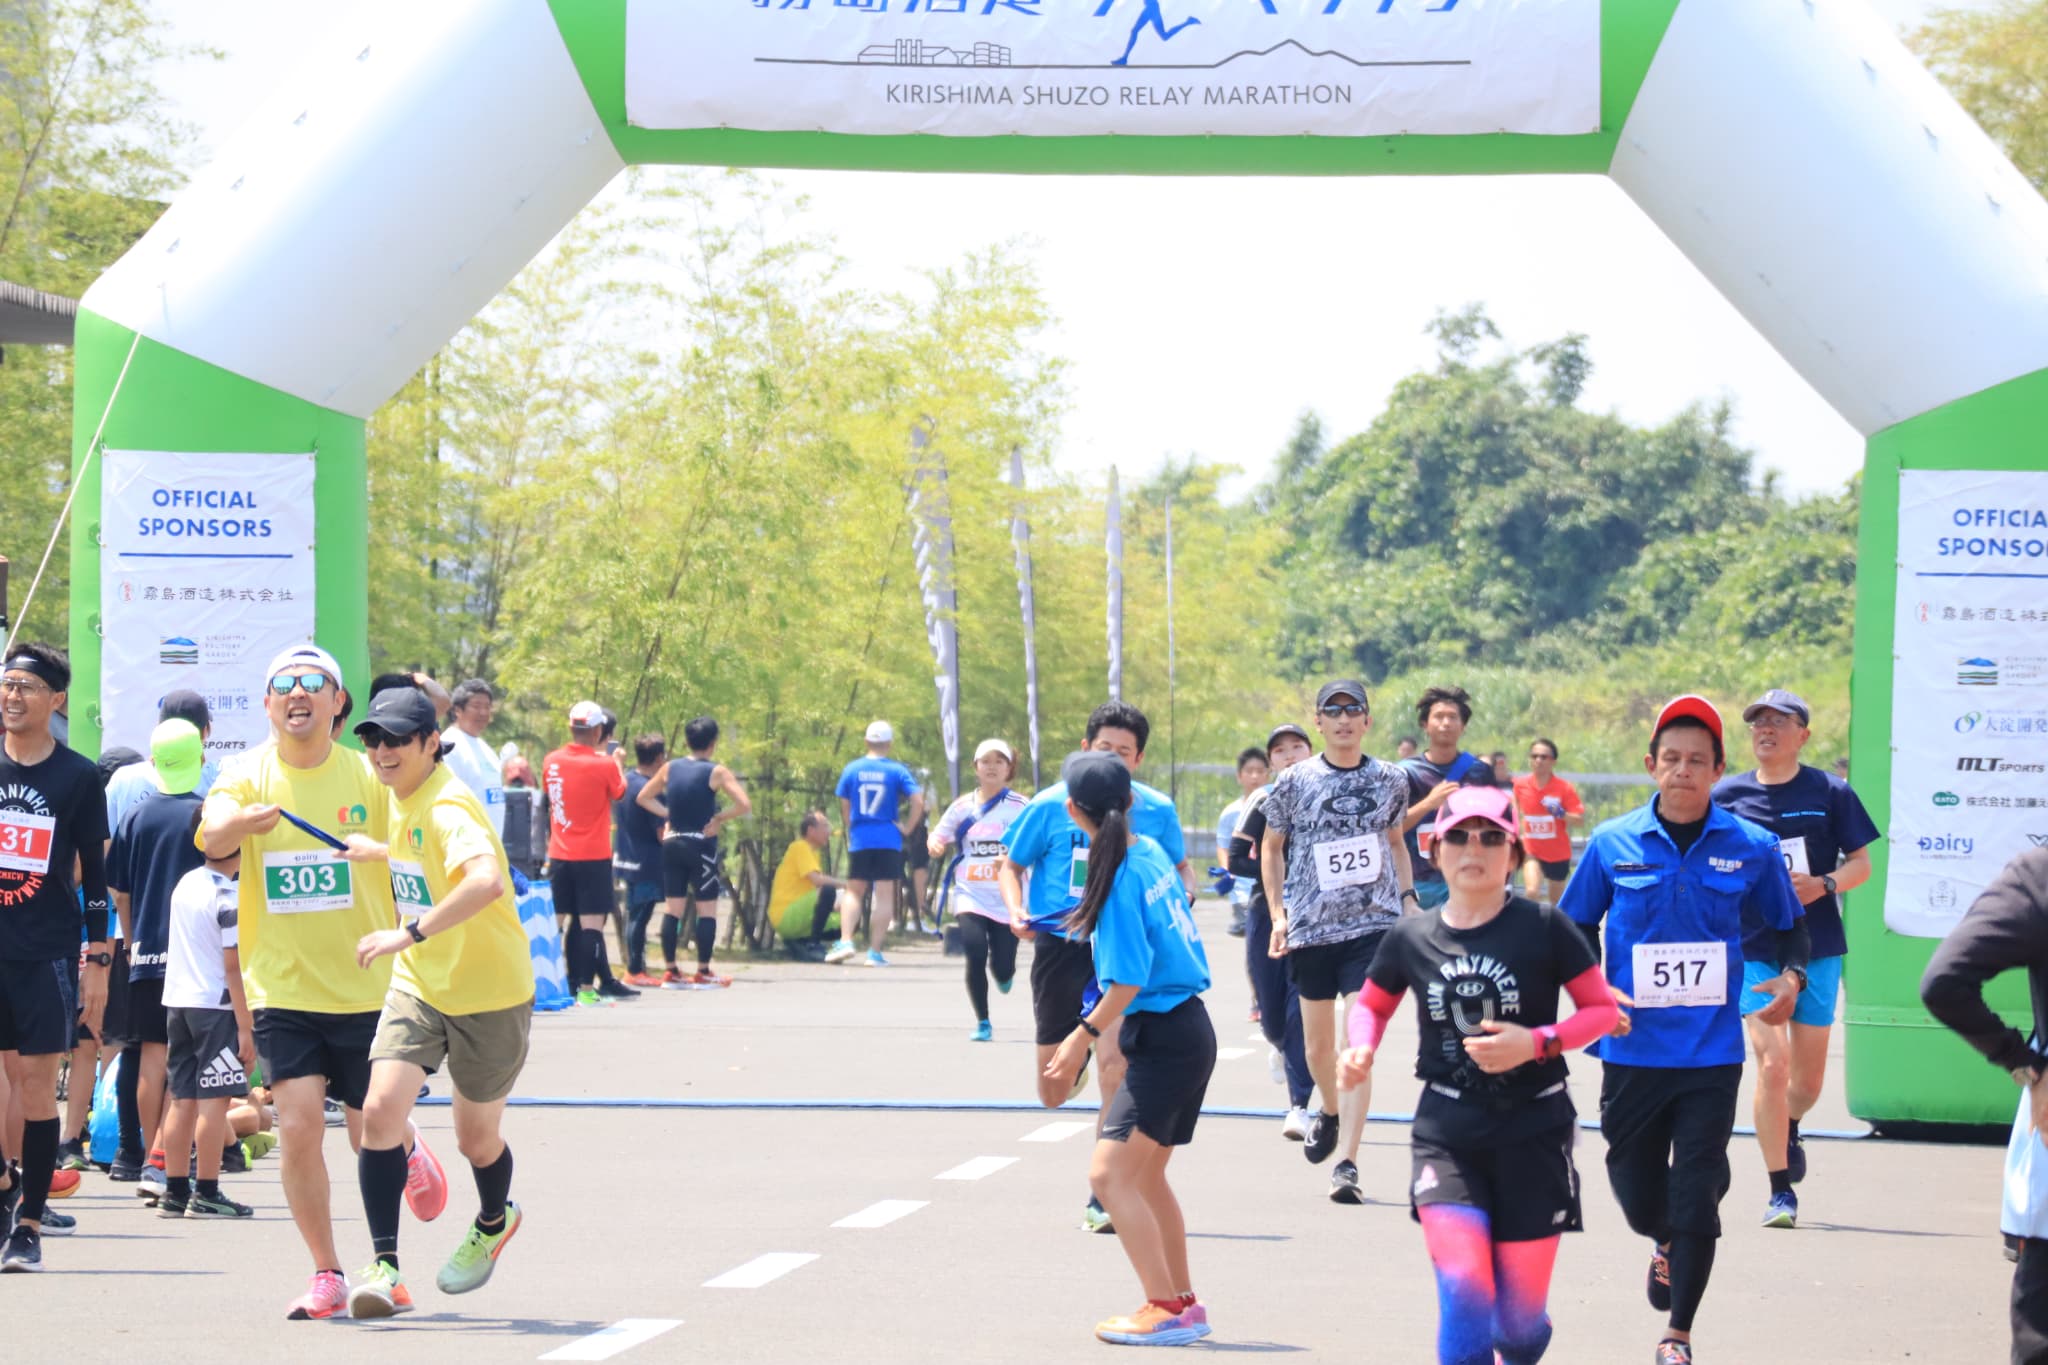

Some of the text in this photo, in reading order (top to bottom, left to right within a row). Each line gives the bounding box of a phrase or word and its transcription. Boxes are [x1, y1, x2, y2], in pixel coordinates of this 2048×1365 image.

[887, 83, 1352, 106] KIRISHIMA SHUZO RELAY MARATHON
[152, 489, 257, 509] OFFICIAL
[138, 517, 272, 538] SPONSORS
[1937, 537, 2048, 557] SPONSO
[143, 585, 294, 602] 霧島酒造株式会社
[858, 783, 886, 817] 17
[973, 840, 1009, 856] Jeep
[1328, 848, 1370, 874] 525
[278, 865, 336, 894] 303
[392, 873, 422, 900] 03
[1653, 960, 1708, 988] 517
[1427, 954, 1520, 1021] RUN ANYWHERE
